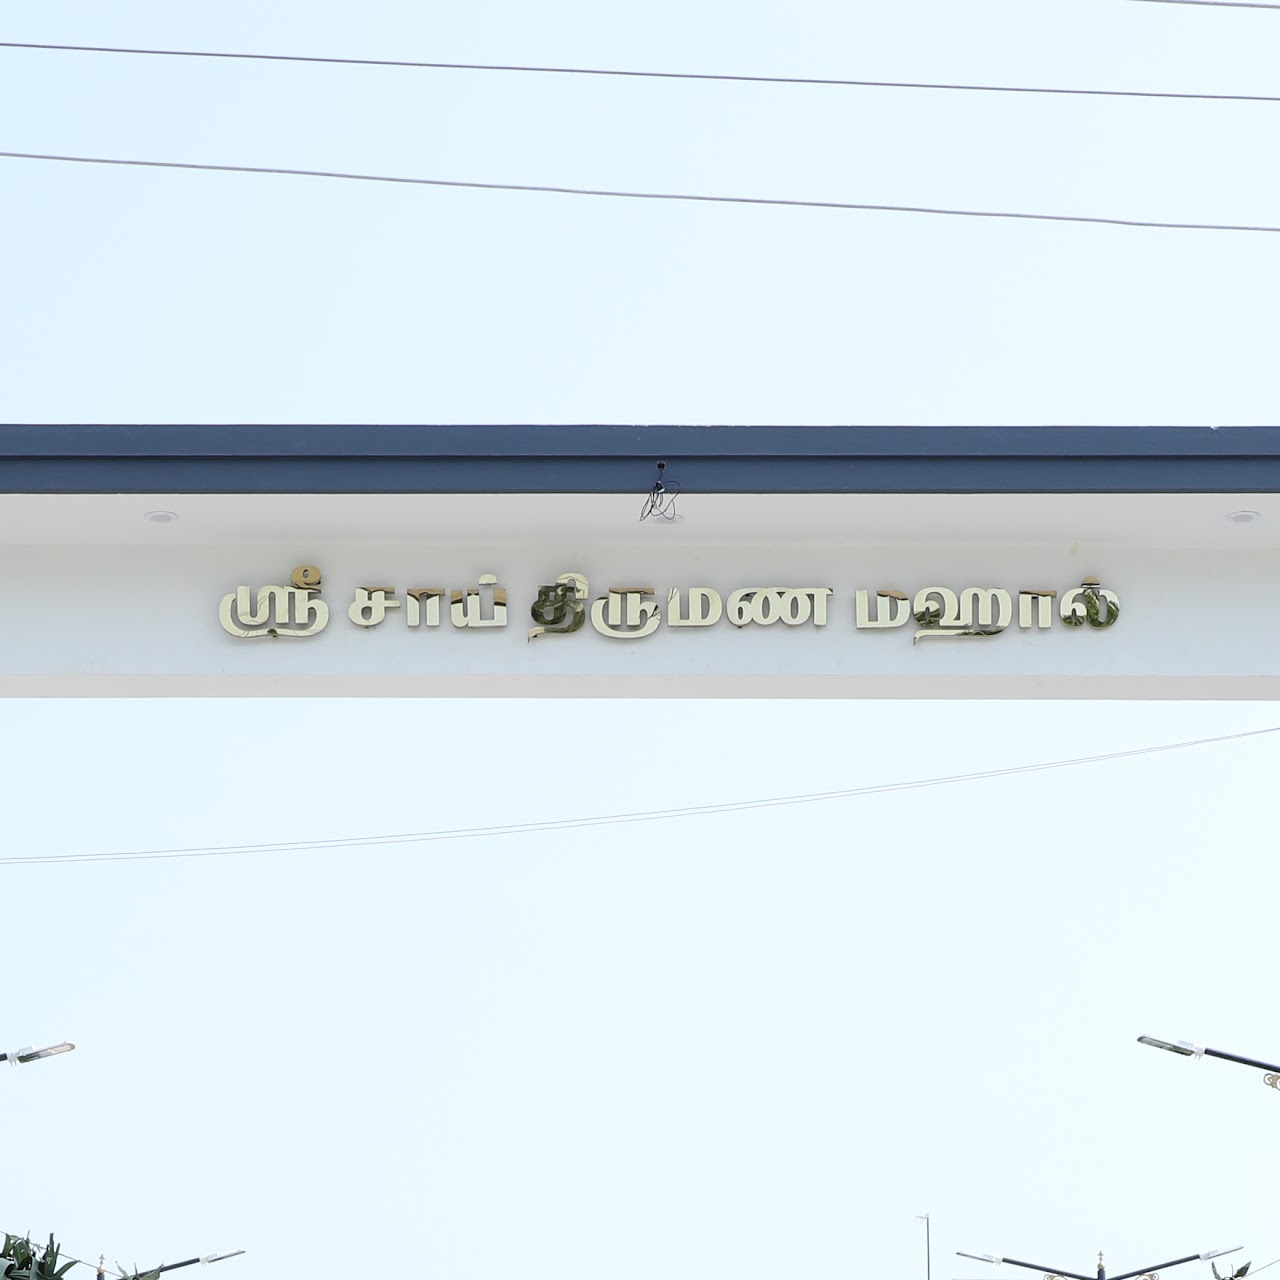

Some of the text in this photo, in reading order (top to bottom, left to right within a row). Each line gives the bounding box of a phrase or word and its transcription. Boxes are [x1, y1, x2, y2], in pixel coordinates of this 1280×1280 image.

[348, 573, 508, 629] சாய்
[527, 572, 834, 644] திருமண
[855, 575, 1121, 647] மஹால்
